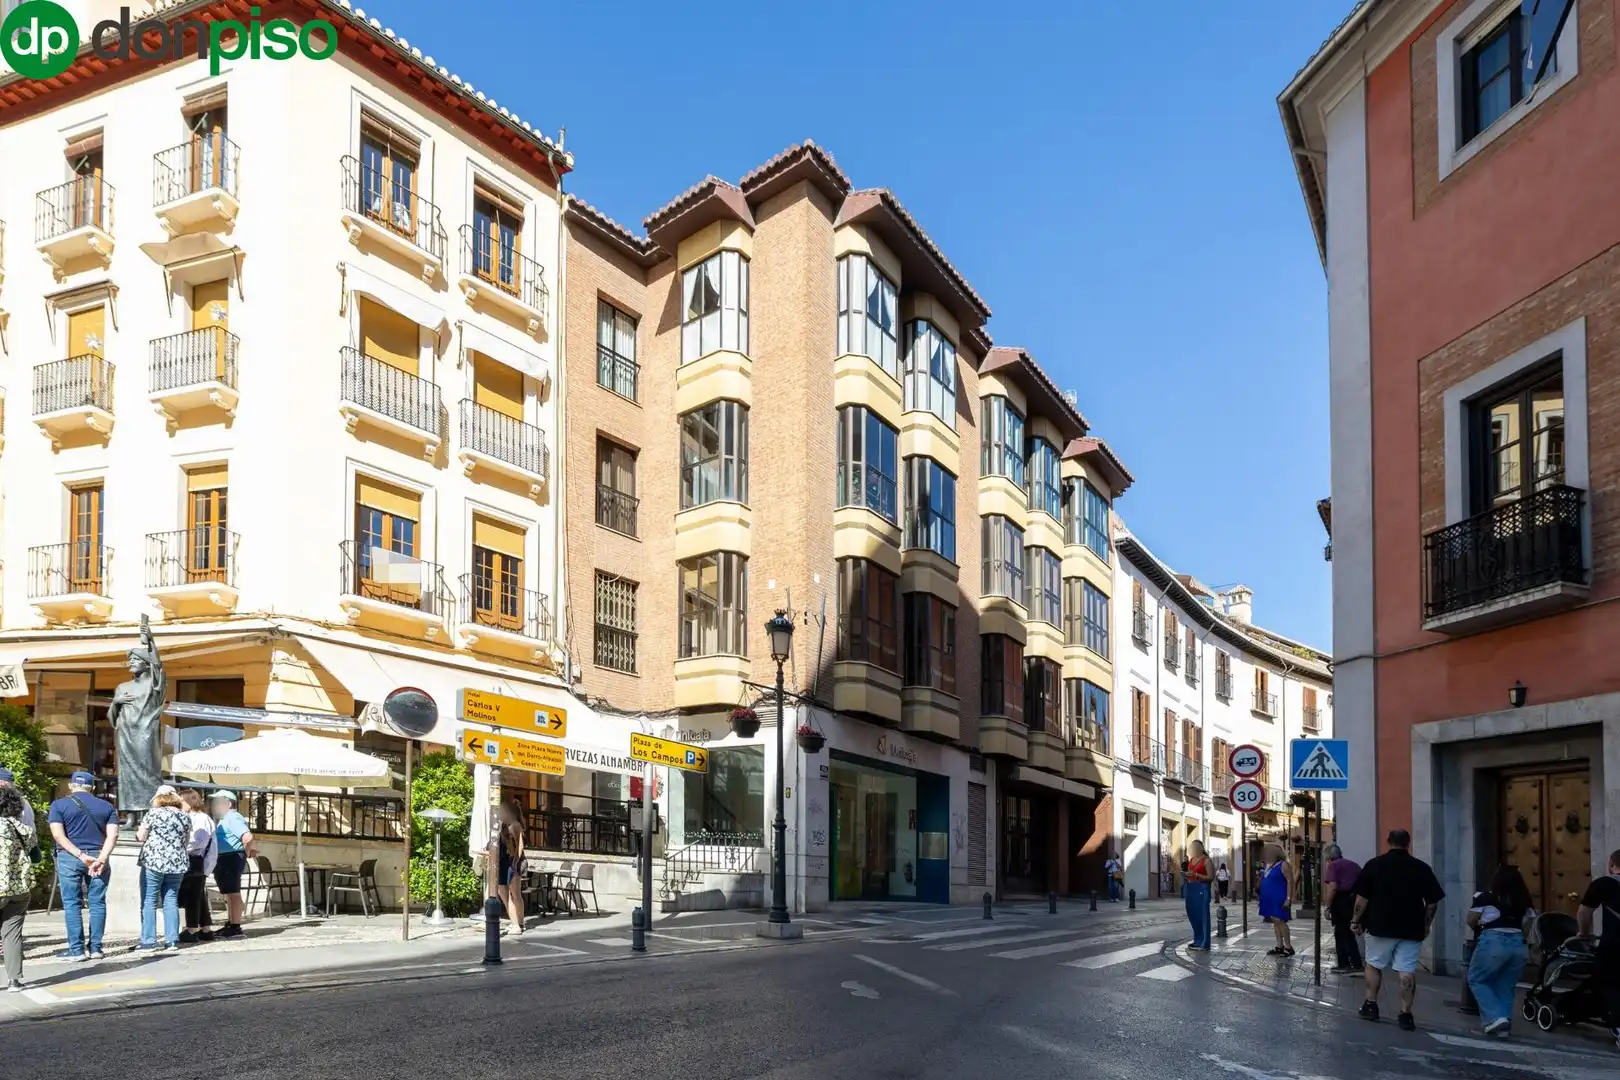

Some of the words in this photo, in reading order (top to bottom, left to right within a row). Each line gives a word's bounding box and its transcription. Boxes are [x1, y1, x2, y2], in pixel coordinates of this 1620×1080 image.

[467, 699, 493, 711] Carlos
[467, 709, 496, 721] Molinos
[633, 737, 651, 747] Plaza
[565, 748, 598, 765] RVEZAS
[633, 747, 648, 757] Los
[651, 750, 684, 764] Campos
[687, 751, 695, 763] P
[890, 743, 918, 763] Unicaja
[1237, 790, 1257, 802] 30
